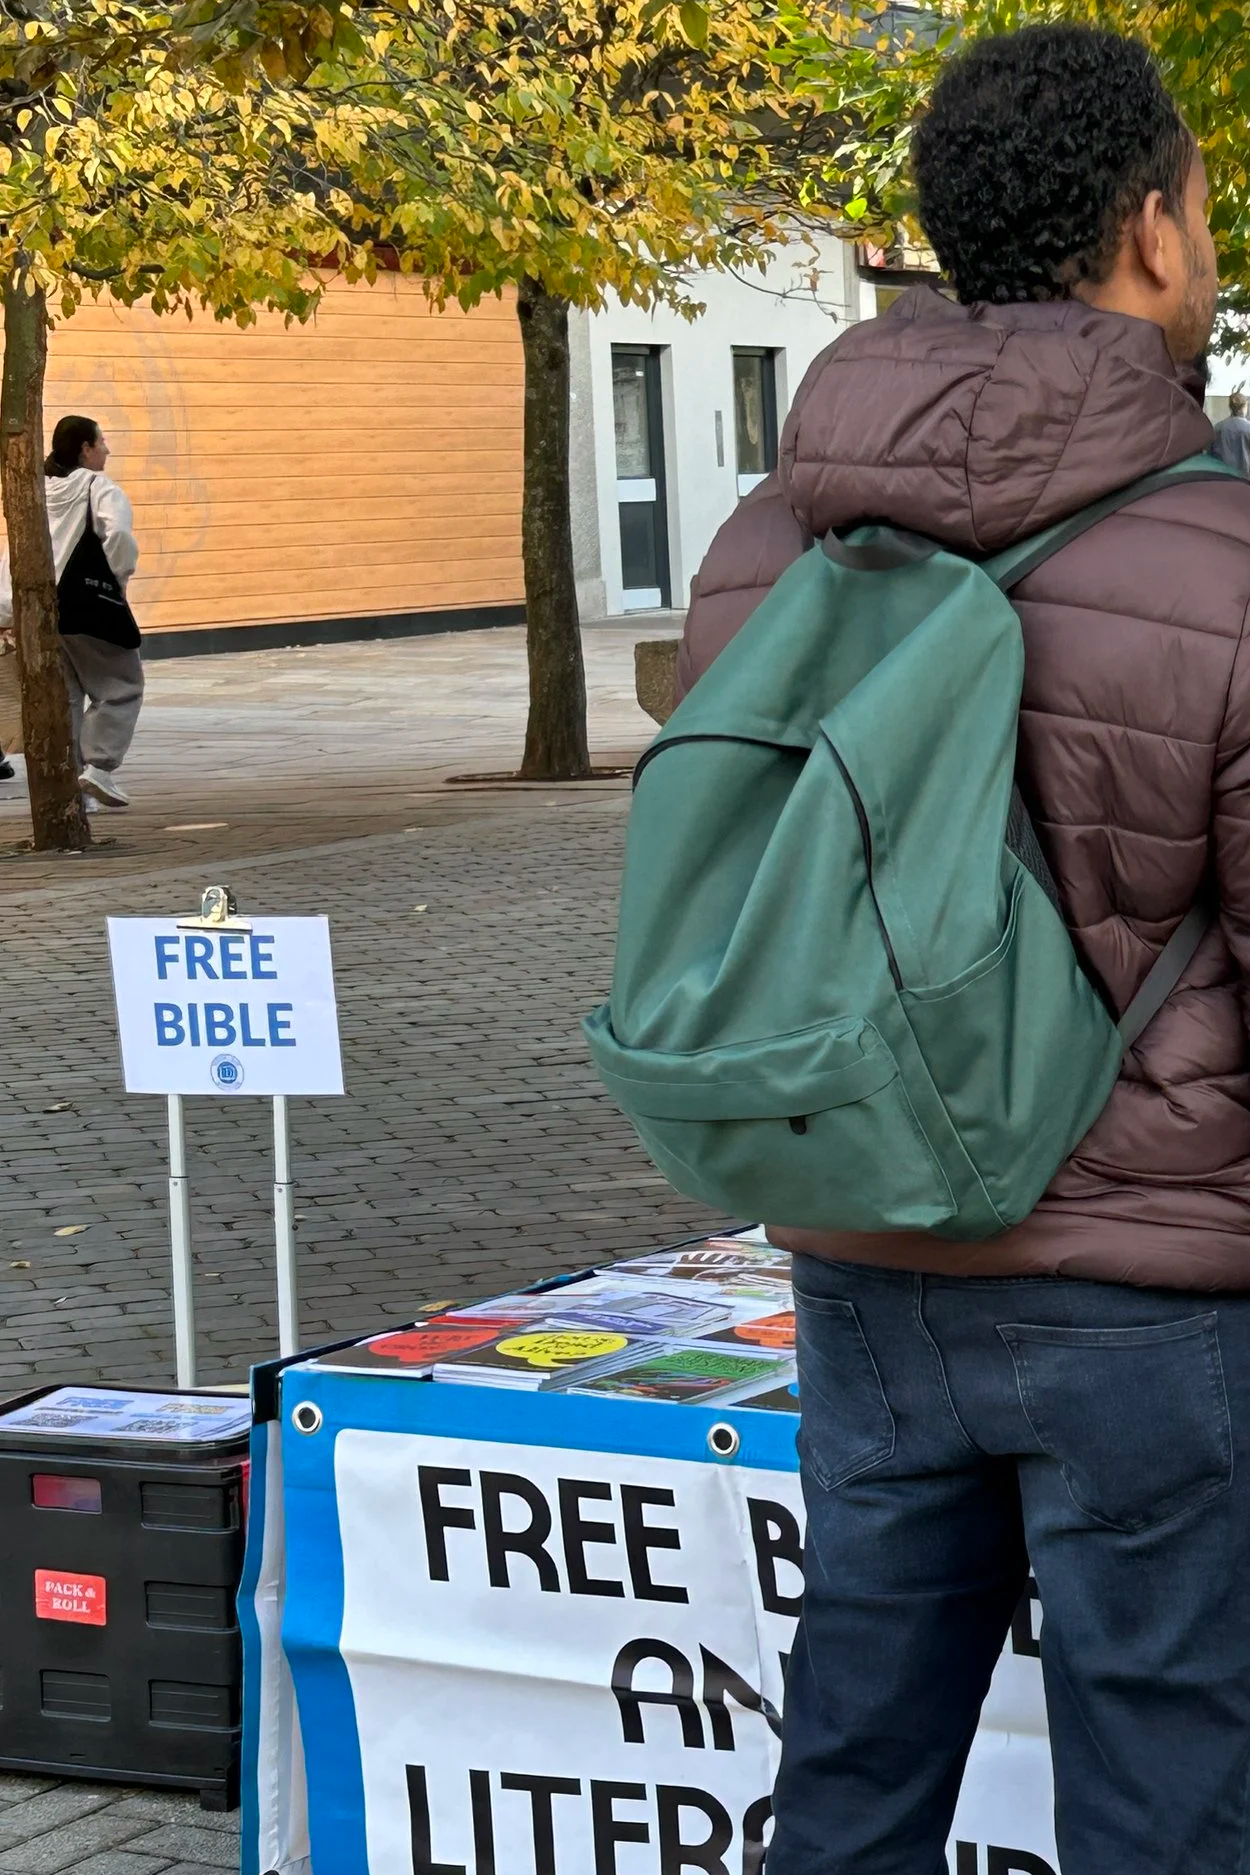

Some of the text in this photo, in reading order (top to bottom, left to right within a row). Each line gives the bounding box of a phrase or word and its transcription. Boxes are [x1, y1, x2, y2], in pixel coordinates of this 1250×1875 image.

[154, 935, 278, 980] FREE
[154, 1002, 297, 1047] BIBLE
[416, 1464, 690, 1604] FREE
[45, 1581, 96, 1599] PACK &
[52, 1597, 91, 1614] ROLL
[610, 1636, 793, 1752] AN
